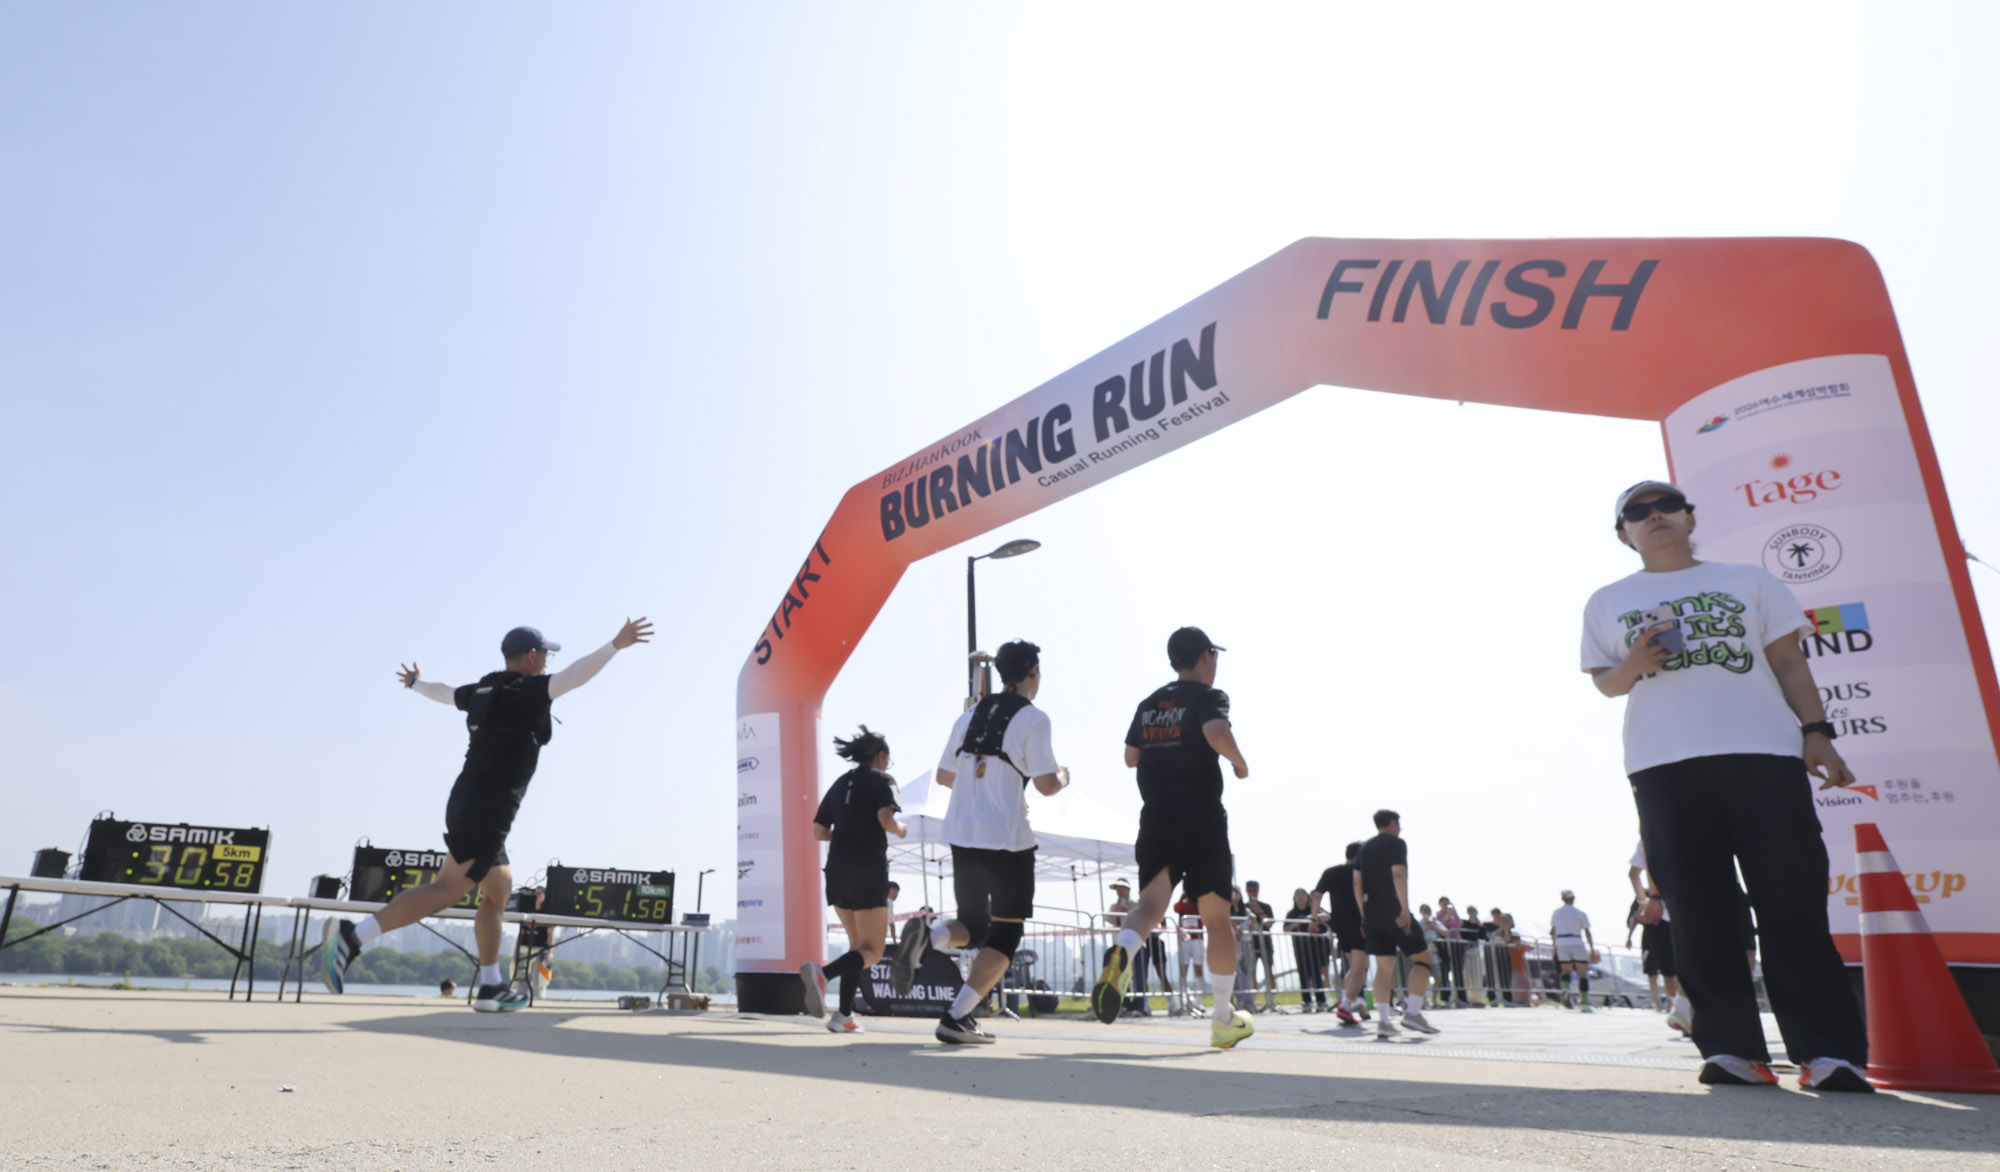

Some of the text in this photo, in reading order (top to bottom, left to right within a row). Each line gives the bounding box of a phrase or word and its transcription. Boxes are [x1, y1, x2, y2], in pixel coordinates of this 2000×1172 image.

[1316, 259, 1661, 331] FINISH
[880, 321, 1218, 542] BURNING RUN
[1037, 391, 1230, 488] Casual Running Festival
[1735, 469, 1842, 507] Tage
[1769, 527, 1828, 550] SUNBODY
[1782, 562, 1830, 580] TANNING
[1801, 629, 1873, 659] IND
[1816, 795, 1862, 807] Vision
[149, 826, 235, 845] SAMIK
[222, 847, 251, 859] 5km
[589, 870, 651, 885] SAMIK
[641, 886, 667, 896] 10km
[872, 982, 956, 1002] WAING LINE
